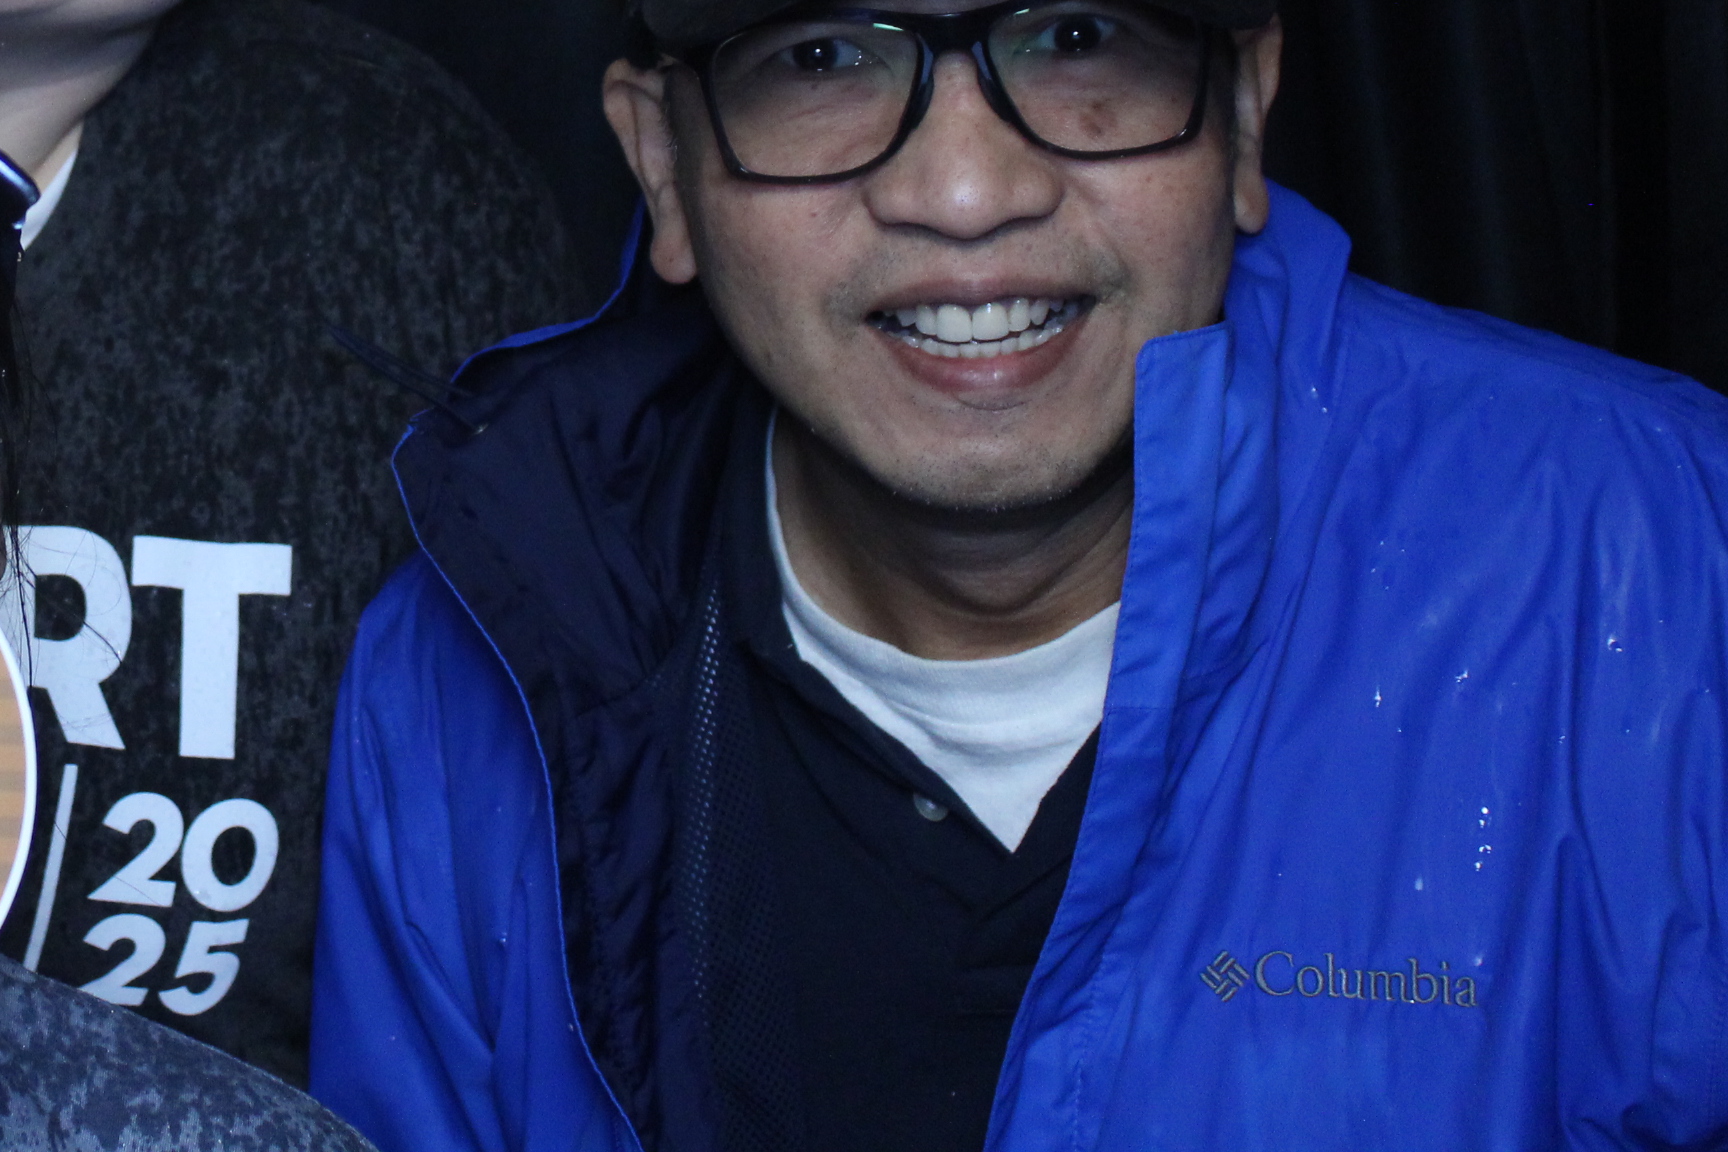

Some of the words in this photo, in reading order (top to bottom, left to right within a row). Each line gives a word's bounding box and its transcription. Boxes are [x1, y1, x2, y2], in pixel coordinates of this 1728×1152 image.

[87, 791, 280, 912] 20
[78, 913, 249, 1016] 25
[1253, 949, 1478, 1009] Columbia
